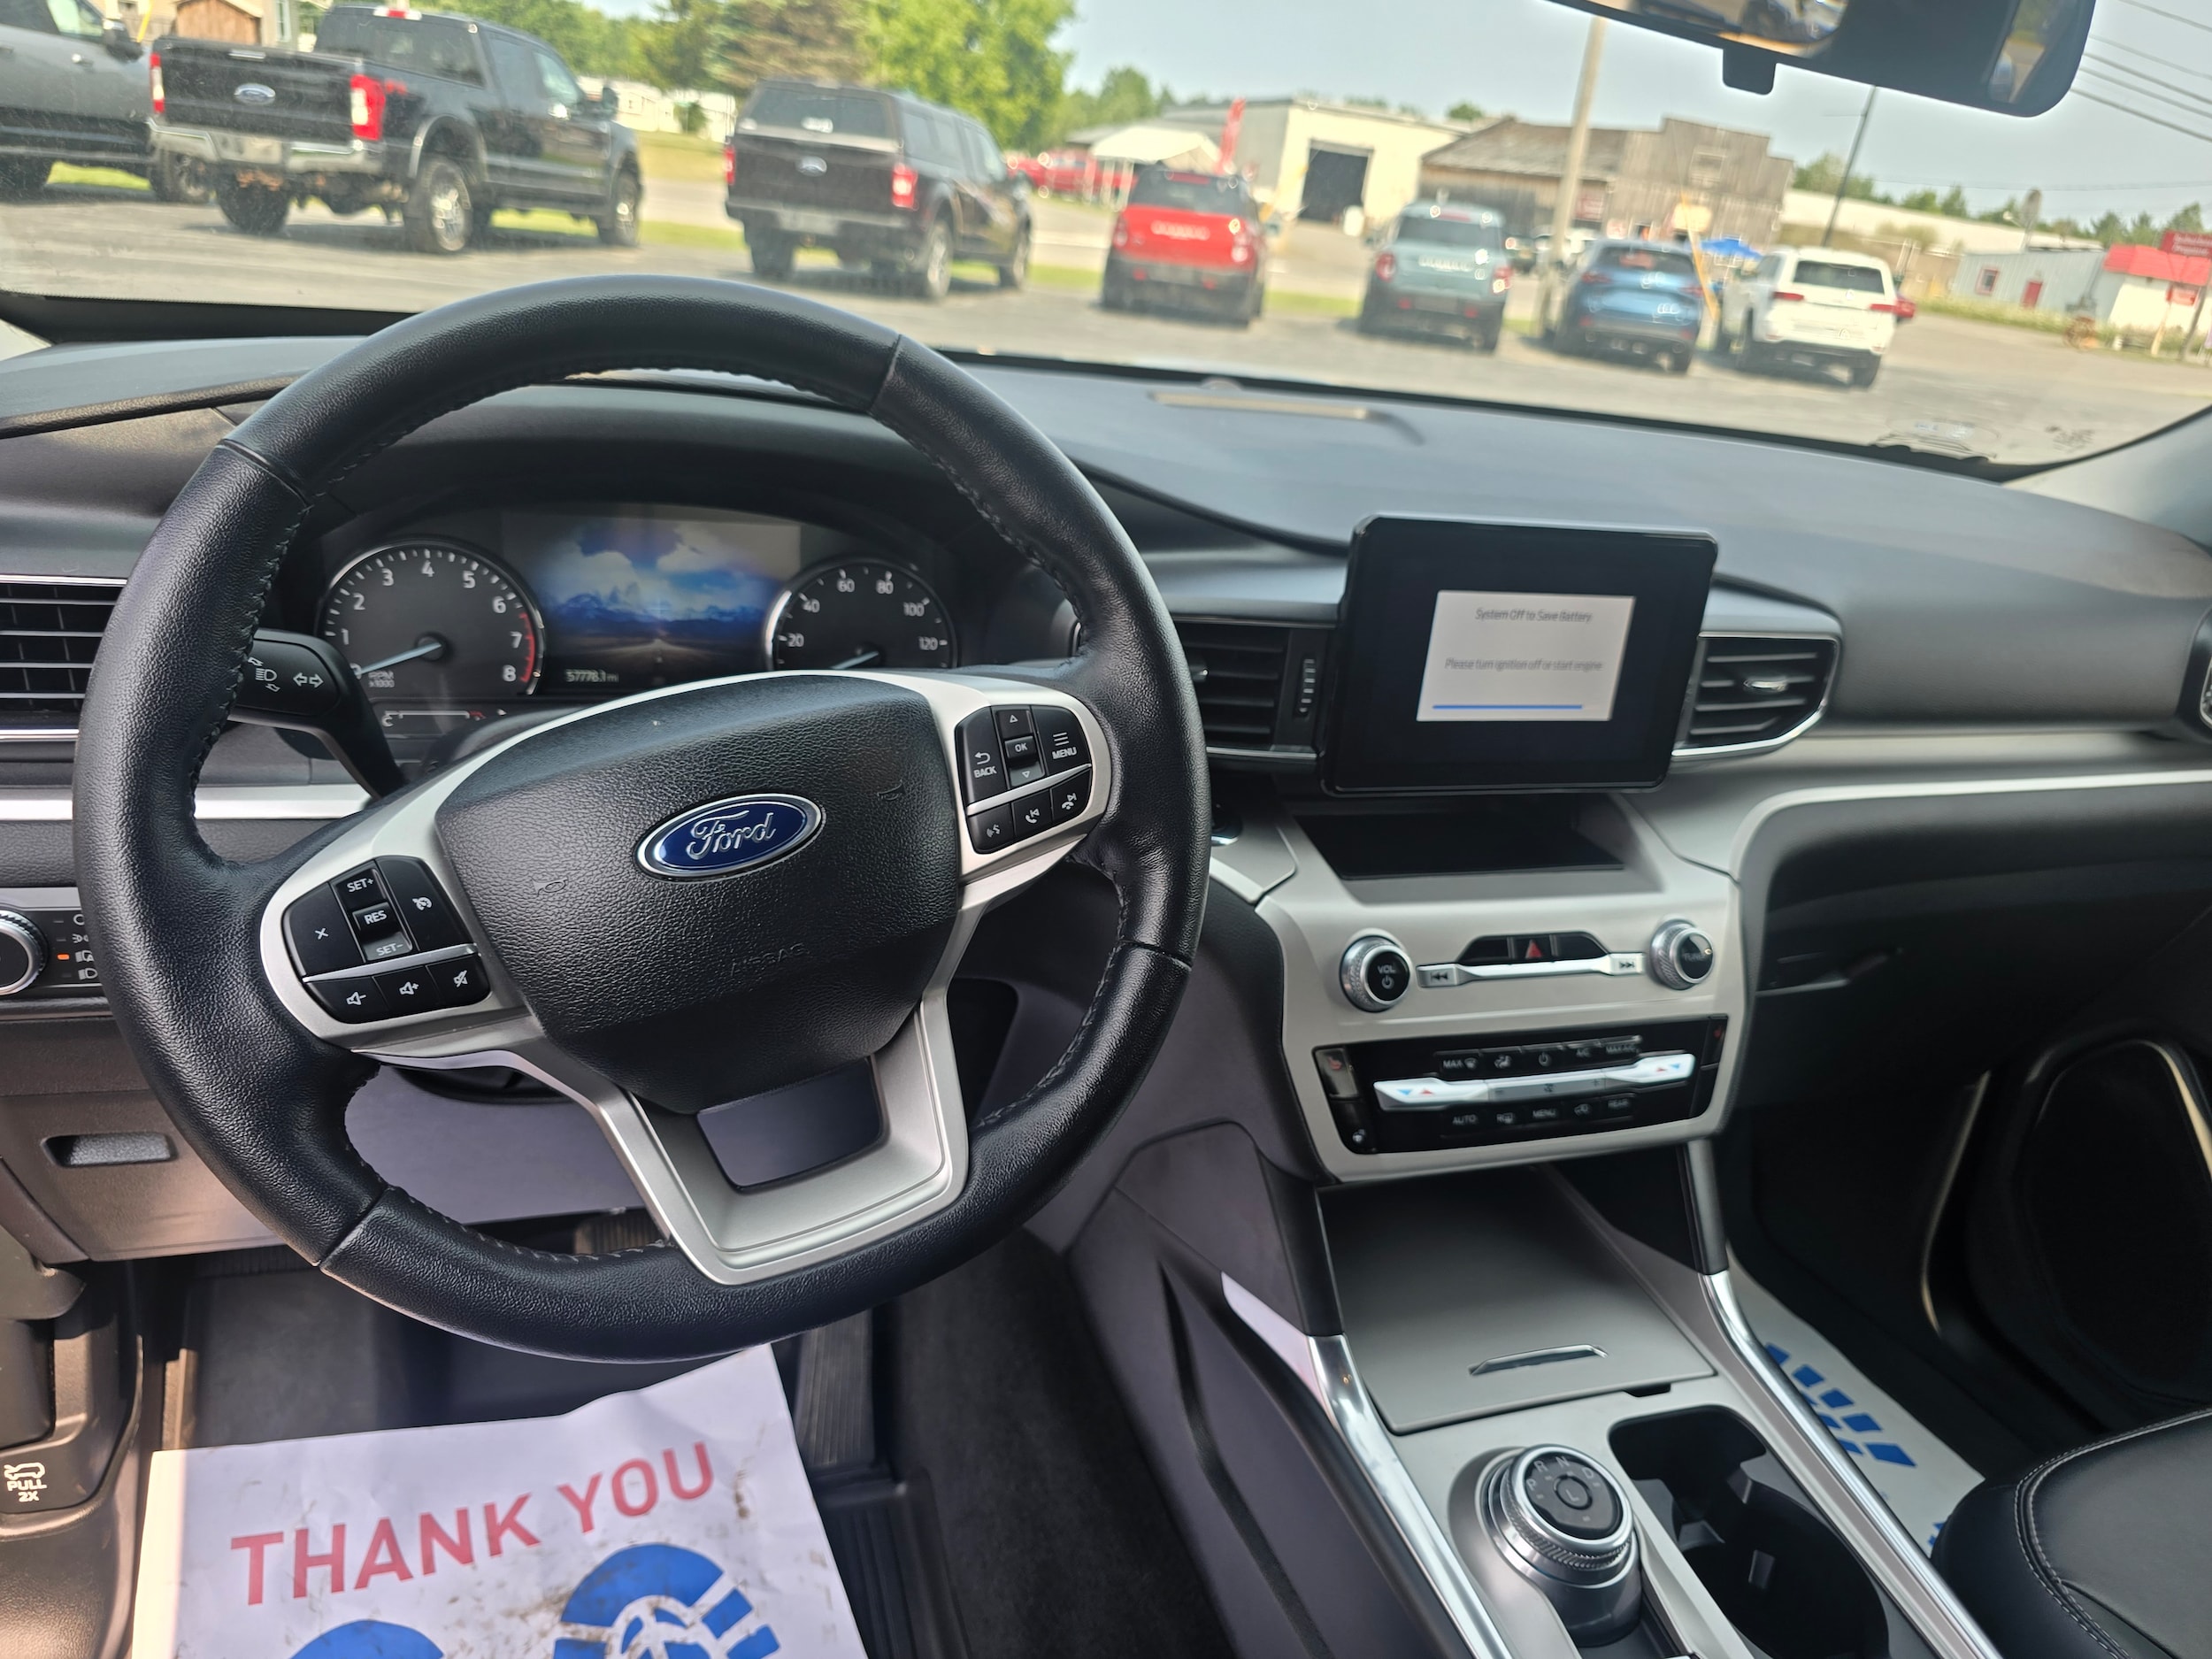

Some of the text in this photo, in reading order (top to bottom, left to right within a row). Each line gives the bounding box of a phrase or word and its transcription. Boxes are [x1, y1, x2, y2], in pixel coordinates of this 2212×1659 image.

[421, 559, 435, 577] 4
[382, 568, 395, 586] 3
[463, 570, 476, 588] 5
[836, 578, 855, 592] 60
[875, 579, 894, 594] 80
[354, 592, 365, 611] 2
[492, 595, 506, 613] 6
[803, 598, 820, 613] 40
[903, 601, 926, 617] 100
[1475, 607, 1593, 624] System Off to Save Battery
[341, 628, 349, 645] 1
[511, 631, 522, 649] 7
[787, 633, 804, 648] 20
[918, 636, 939, 651] 120
[1444, 657, 1474, 670] Please
[1475, 658, 1494, 670] turn
[1494, 658, 1527, 672] ignition
[1527, 657, 1542, 670] off
[1552, 659, 1574, 671] start
[1574, 661, 1602, 672] engine
[368, 670, 395, 680] RPM
[503, 664, 517, 682] 8
[1014, 742, 1028, 753] OK
[1051, 747, 1078, 760] MENU
[973, 765, 998, 779] BACK
[686, 809, 776, 860] Ford
[364, 910, 388, 926] RES
[1377, 964, 1396, 974] VOL
[1443, 1059, 1464, 1069] MAX
[1452, 1115, 1478, 1125] AUTO
[1532, 1109, 1555, 1119] MENU
[1533, 1460, 1548, 1472] R
[1555, 1455, 1571, 1469] N
[1581, 1467, 1594, 1480] D
[7, 1479, 48, 1492] PULL
[1526, 1478, 1537, 1492] P
[18, 1490, 40, 1502] 2X
[1565, 1489, 1579, 1502] L
[229, 1440, 717, 1606] THANK YOU
